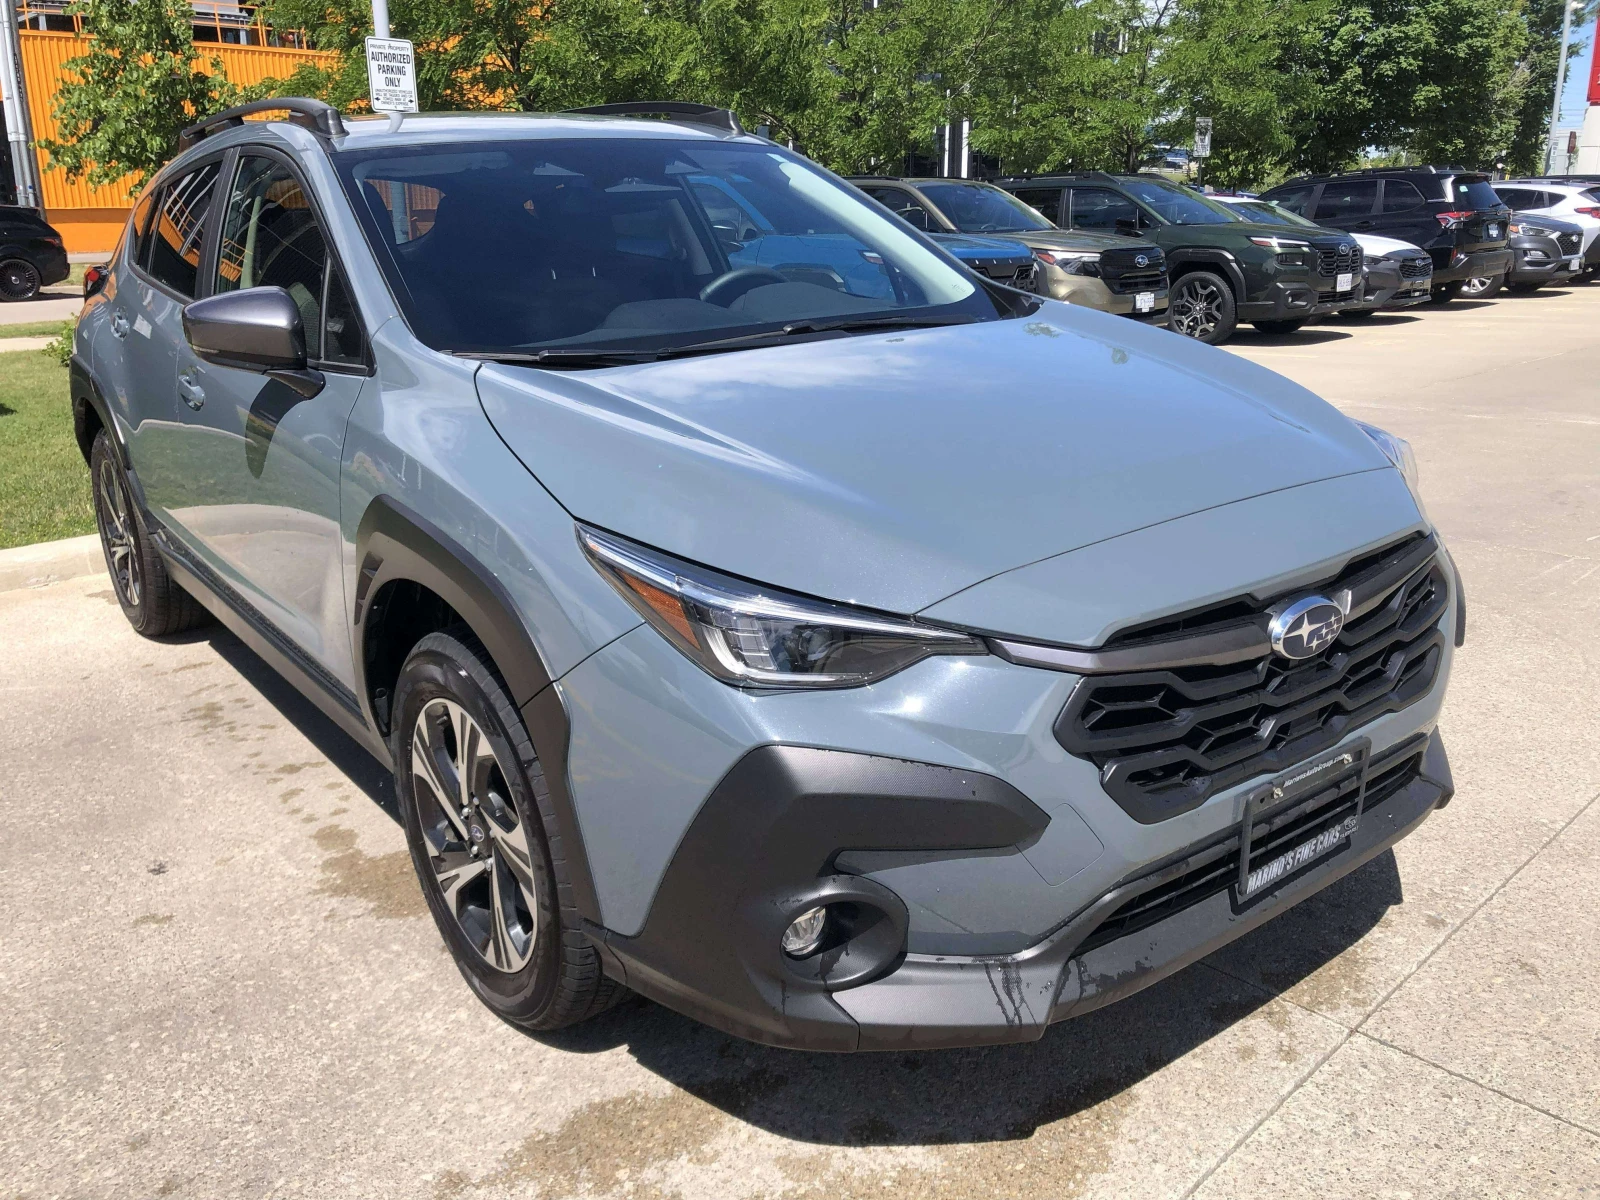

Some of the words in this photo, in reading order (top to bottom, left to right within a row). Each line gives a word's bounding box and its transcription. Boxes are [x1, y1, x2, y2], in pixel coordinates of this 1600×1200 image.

[371, 51, 411, 64] AUTHORIZED
[378, 64, 406, 76] PARKING
[385, 76, 400, 87] ONLY
[1246, 852, 1295, 895] MARINO'S
[1294, 838, 1316, 866] FINE
[1316, 825, 1342, 853] CARS
